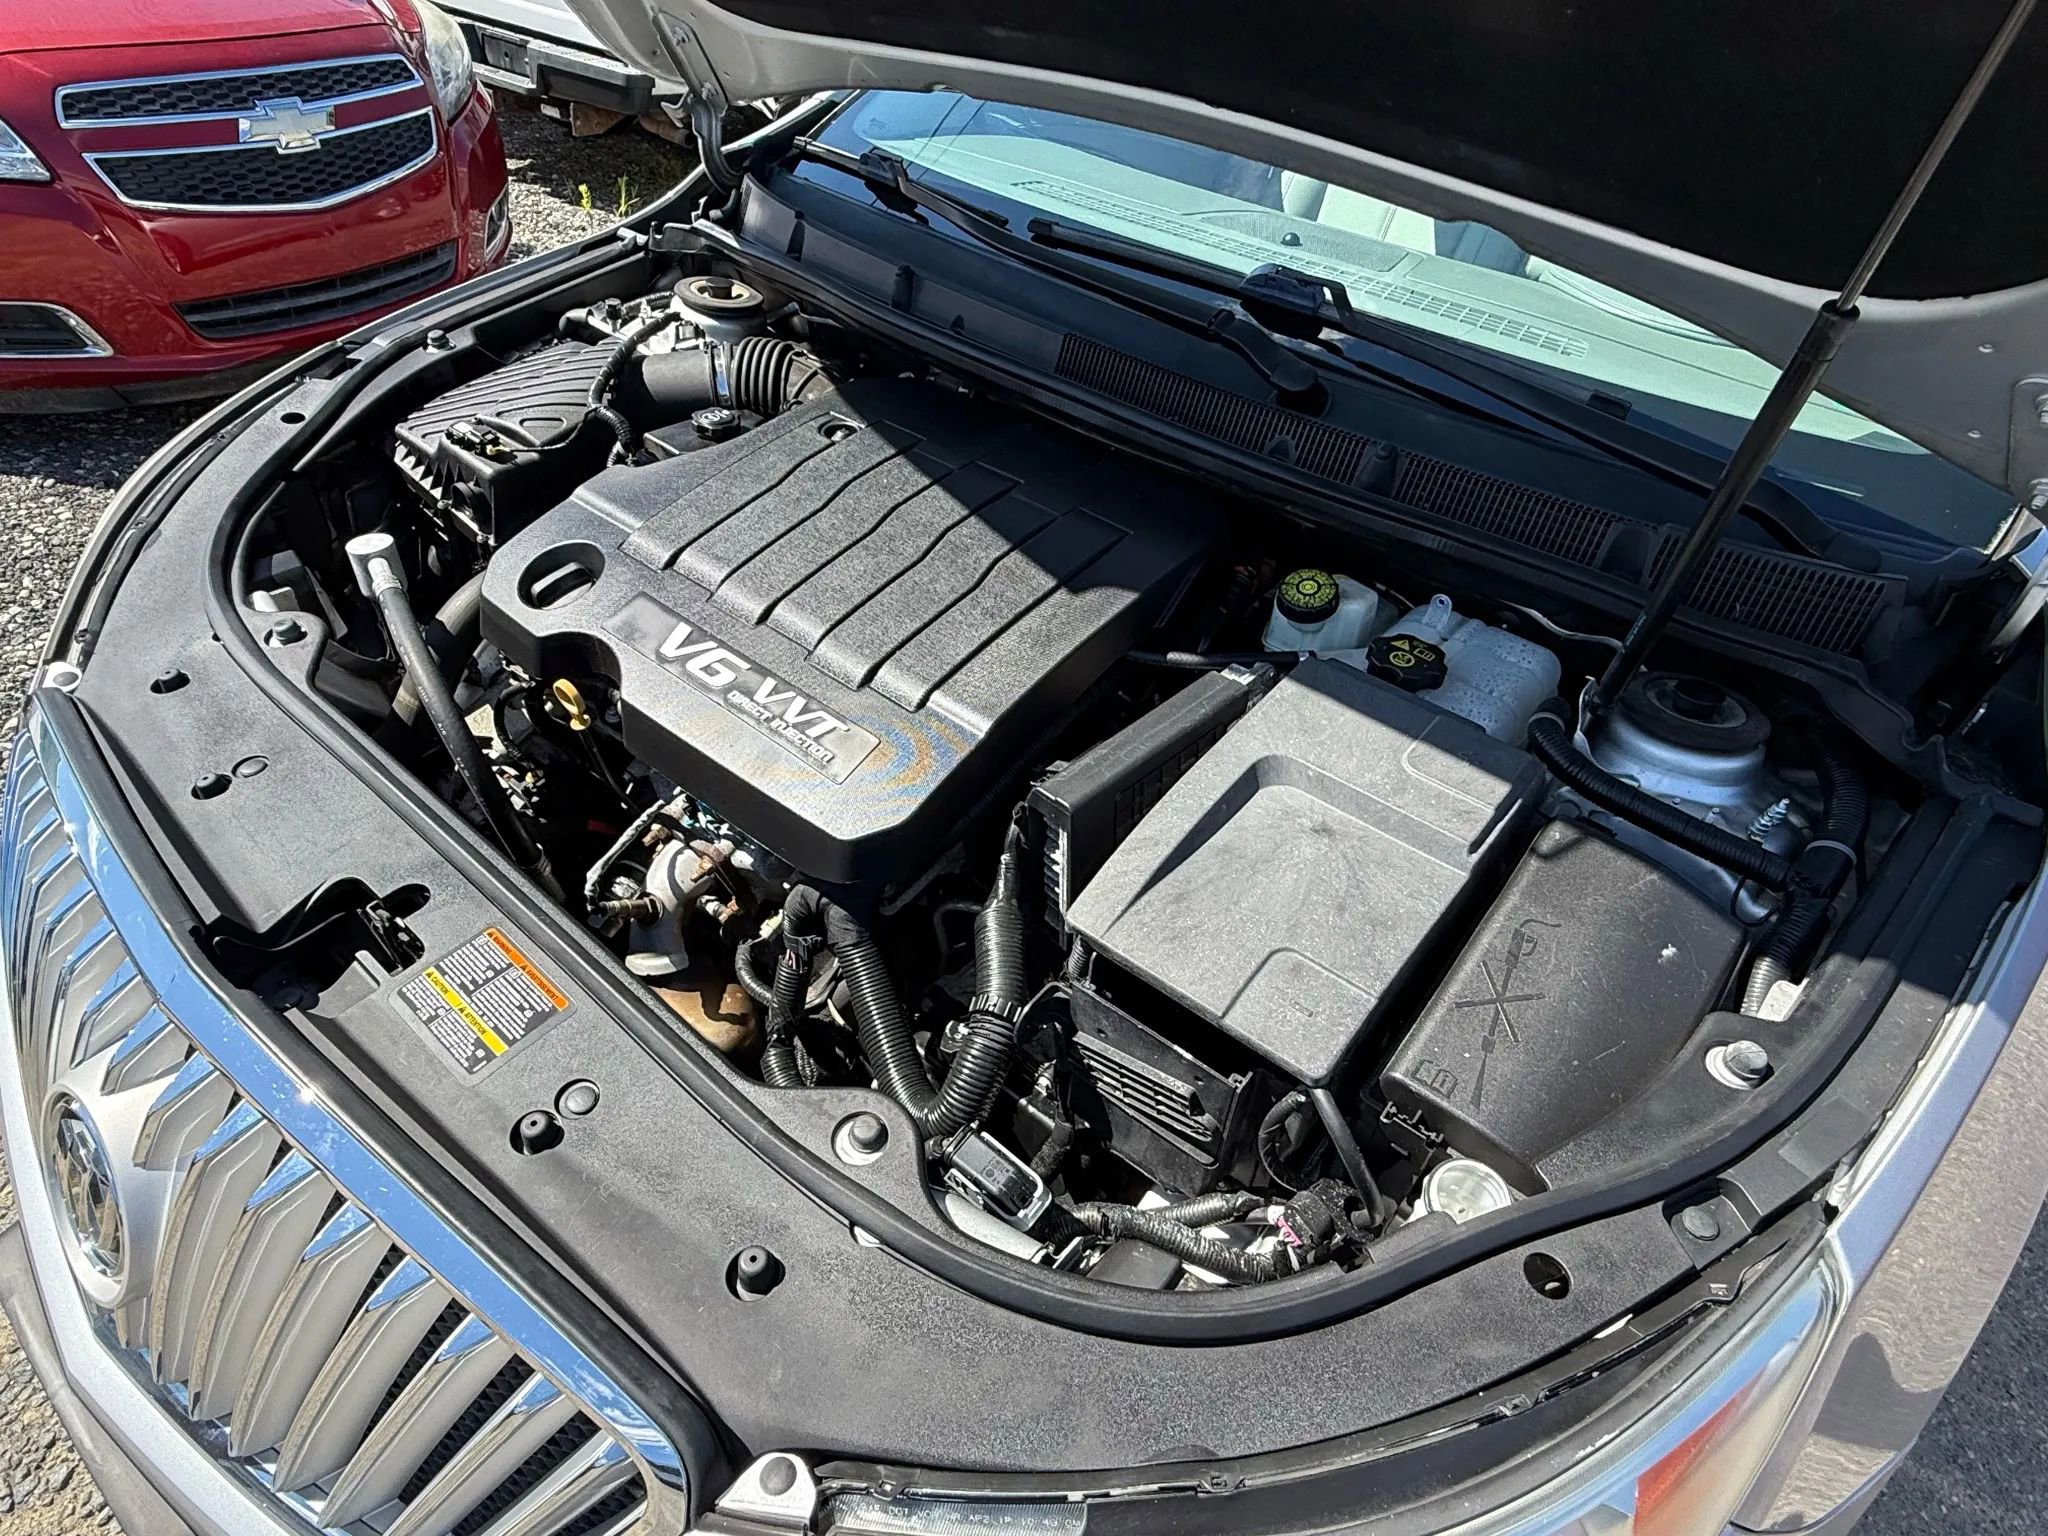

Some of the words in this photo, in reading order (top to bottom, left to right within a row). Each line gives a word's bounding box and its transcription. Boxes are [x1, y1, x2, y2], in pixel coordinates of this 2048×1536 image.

[659, 622, 752, 687] V6
[753, 677, 850, 738] VVT
[727, 690, 773, 723] DIRECT
[770, 718, 835, 763] INJECTION
[431, 977, 449, 995] CAUTION
[464, 1012, 488, 1035] ATTENTION
